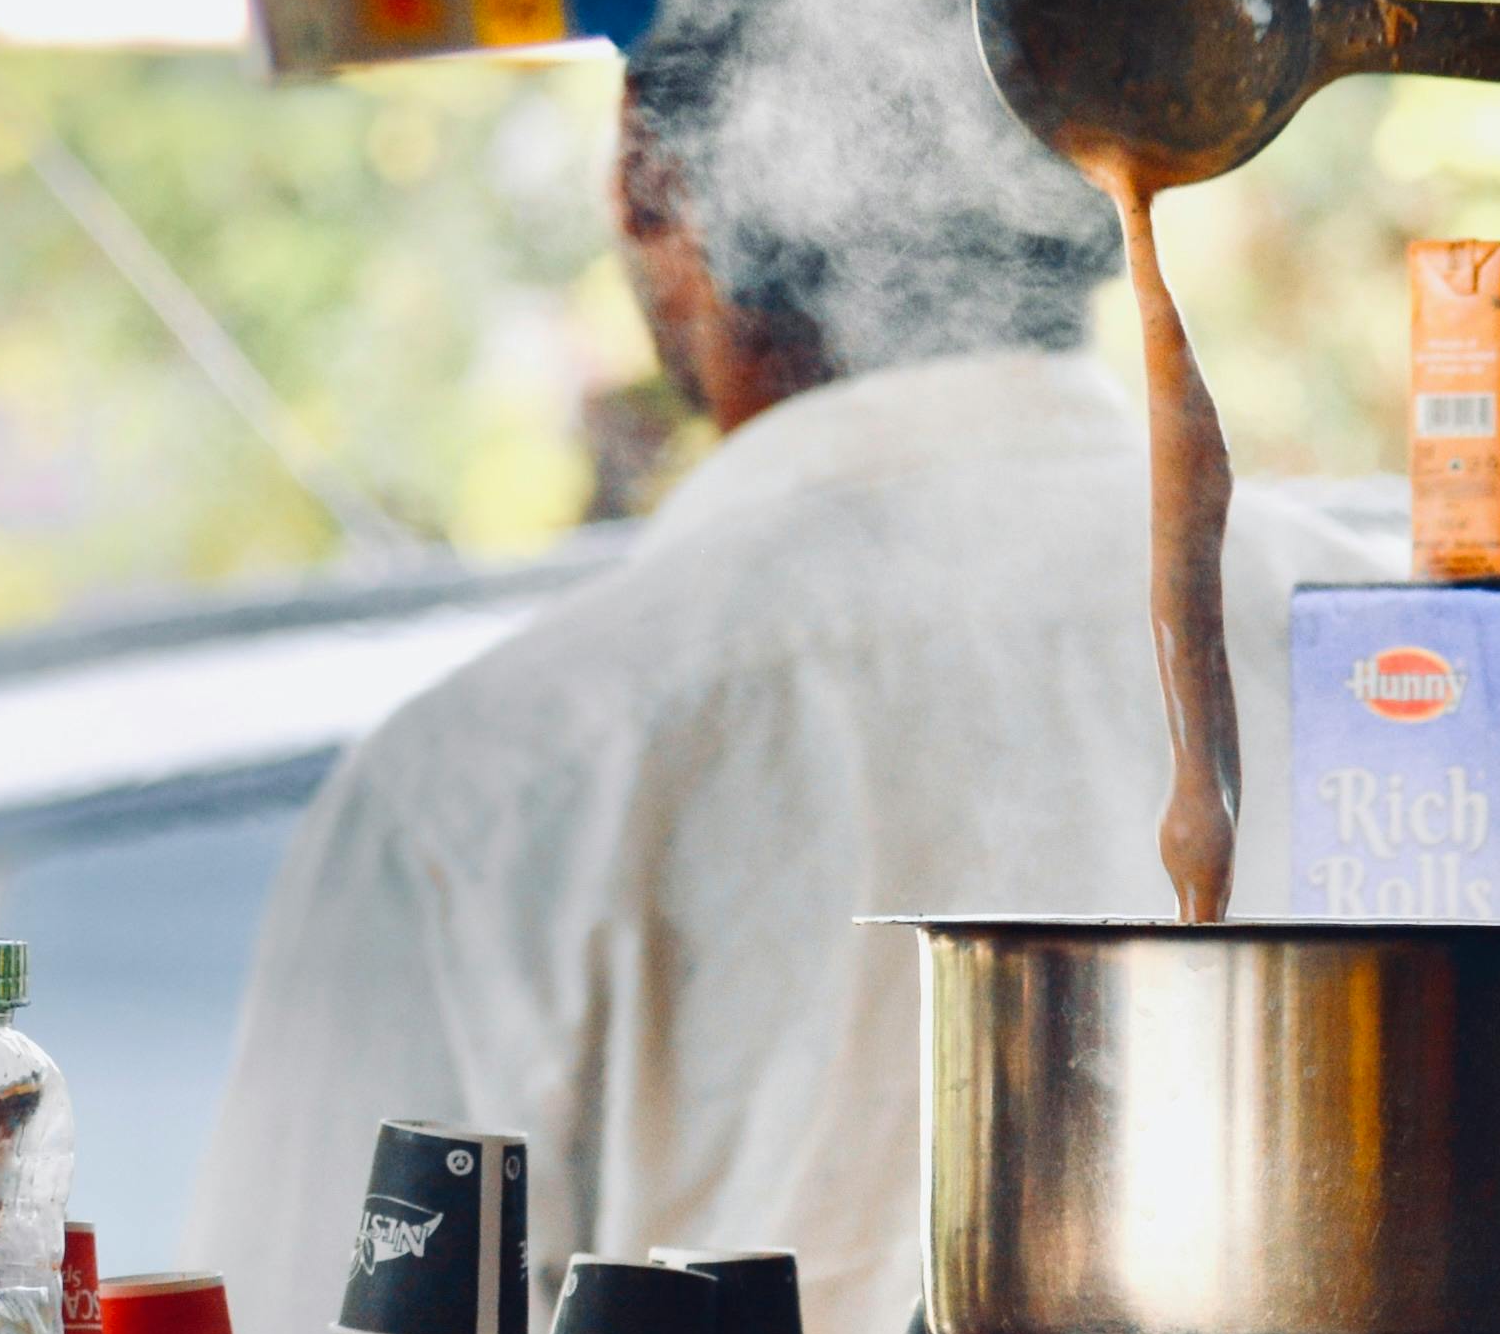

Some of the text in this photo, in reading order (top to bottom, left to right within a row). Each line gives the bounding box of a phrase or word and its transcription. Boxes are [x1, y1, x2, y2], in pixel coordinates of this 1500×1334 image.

[1345, 656, 1467, 715] Hunny
[1318, 765, 1490, 860] Rich
[1308, 851, 1495, 917] Rolls
